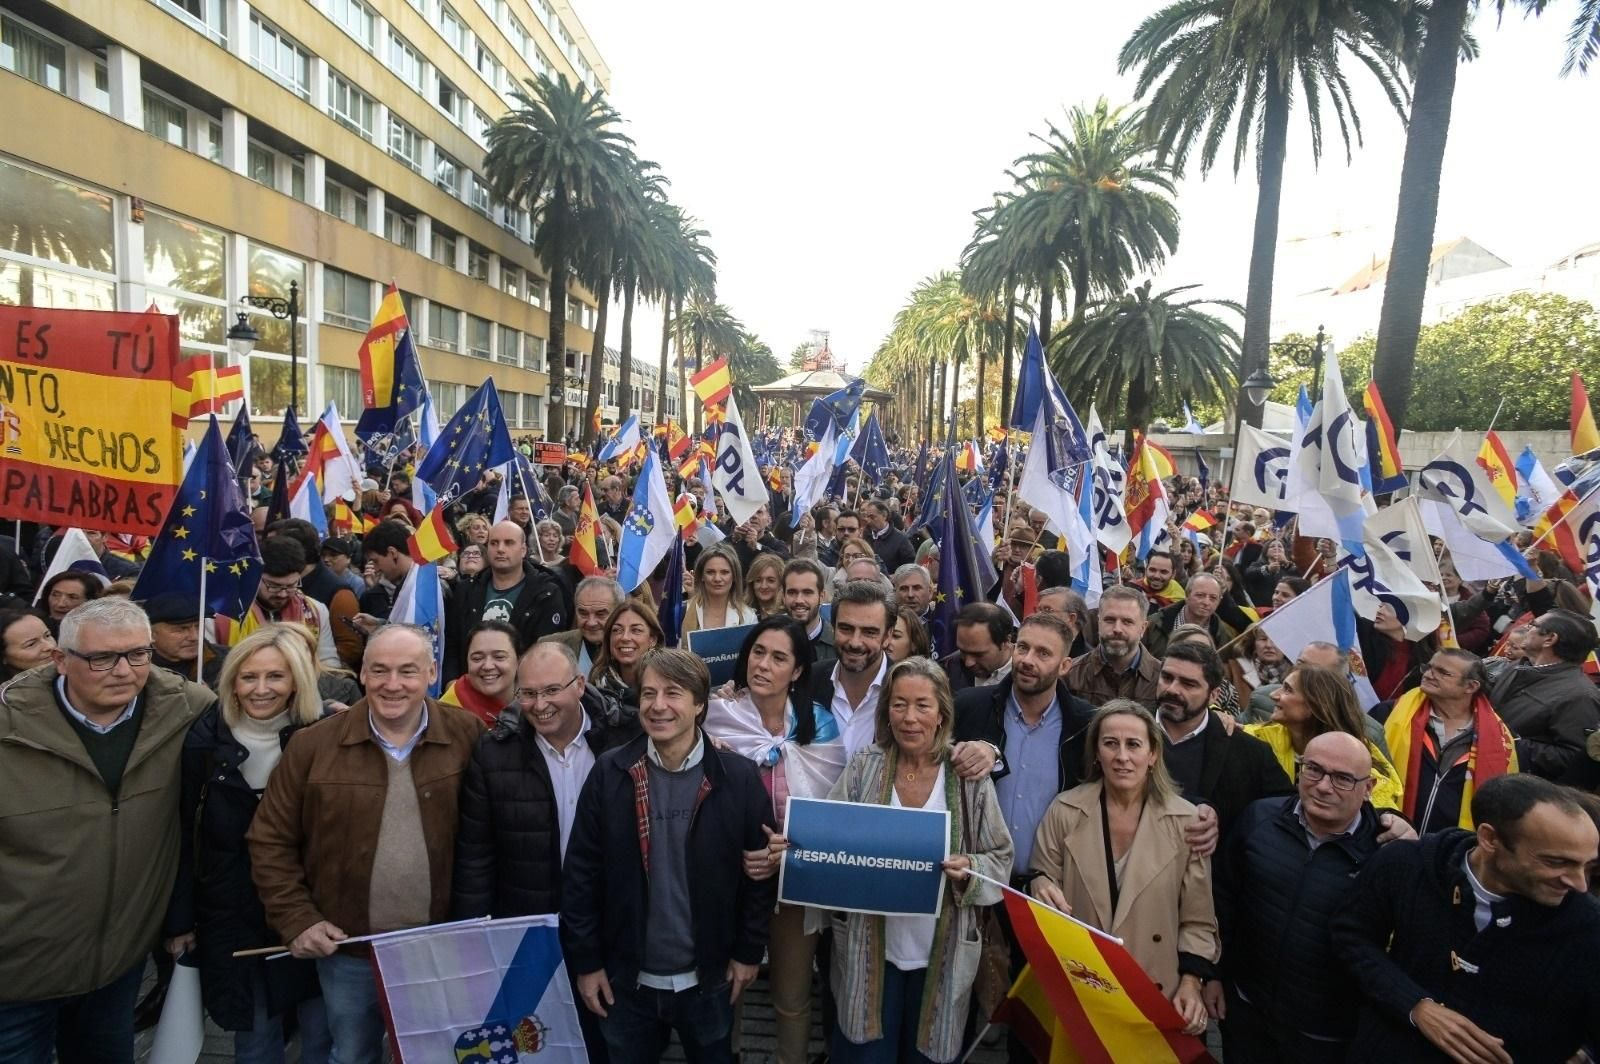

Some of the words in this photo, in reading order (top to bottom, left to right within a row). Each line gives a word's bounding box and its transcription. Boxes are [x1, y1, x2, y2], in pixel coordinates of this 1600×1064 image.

[16, 320, 51, 360] ES
[107, 325, 155, 374] TÚ
[44, 420, 161, 474] HECHOS
[535, 443, 544, 451] SE
[3, 469, 163, 527] PALABRAS
[793, 848, 934, 874] #ESPAÑANOSERINDE
